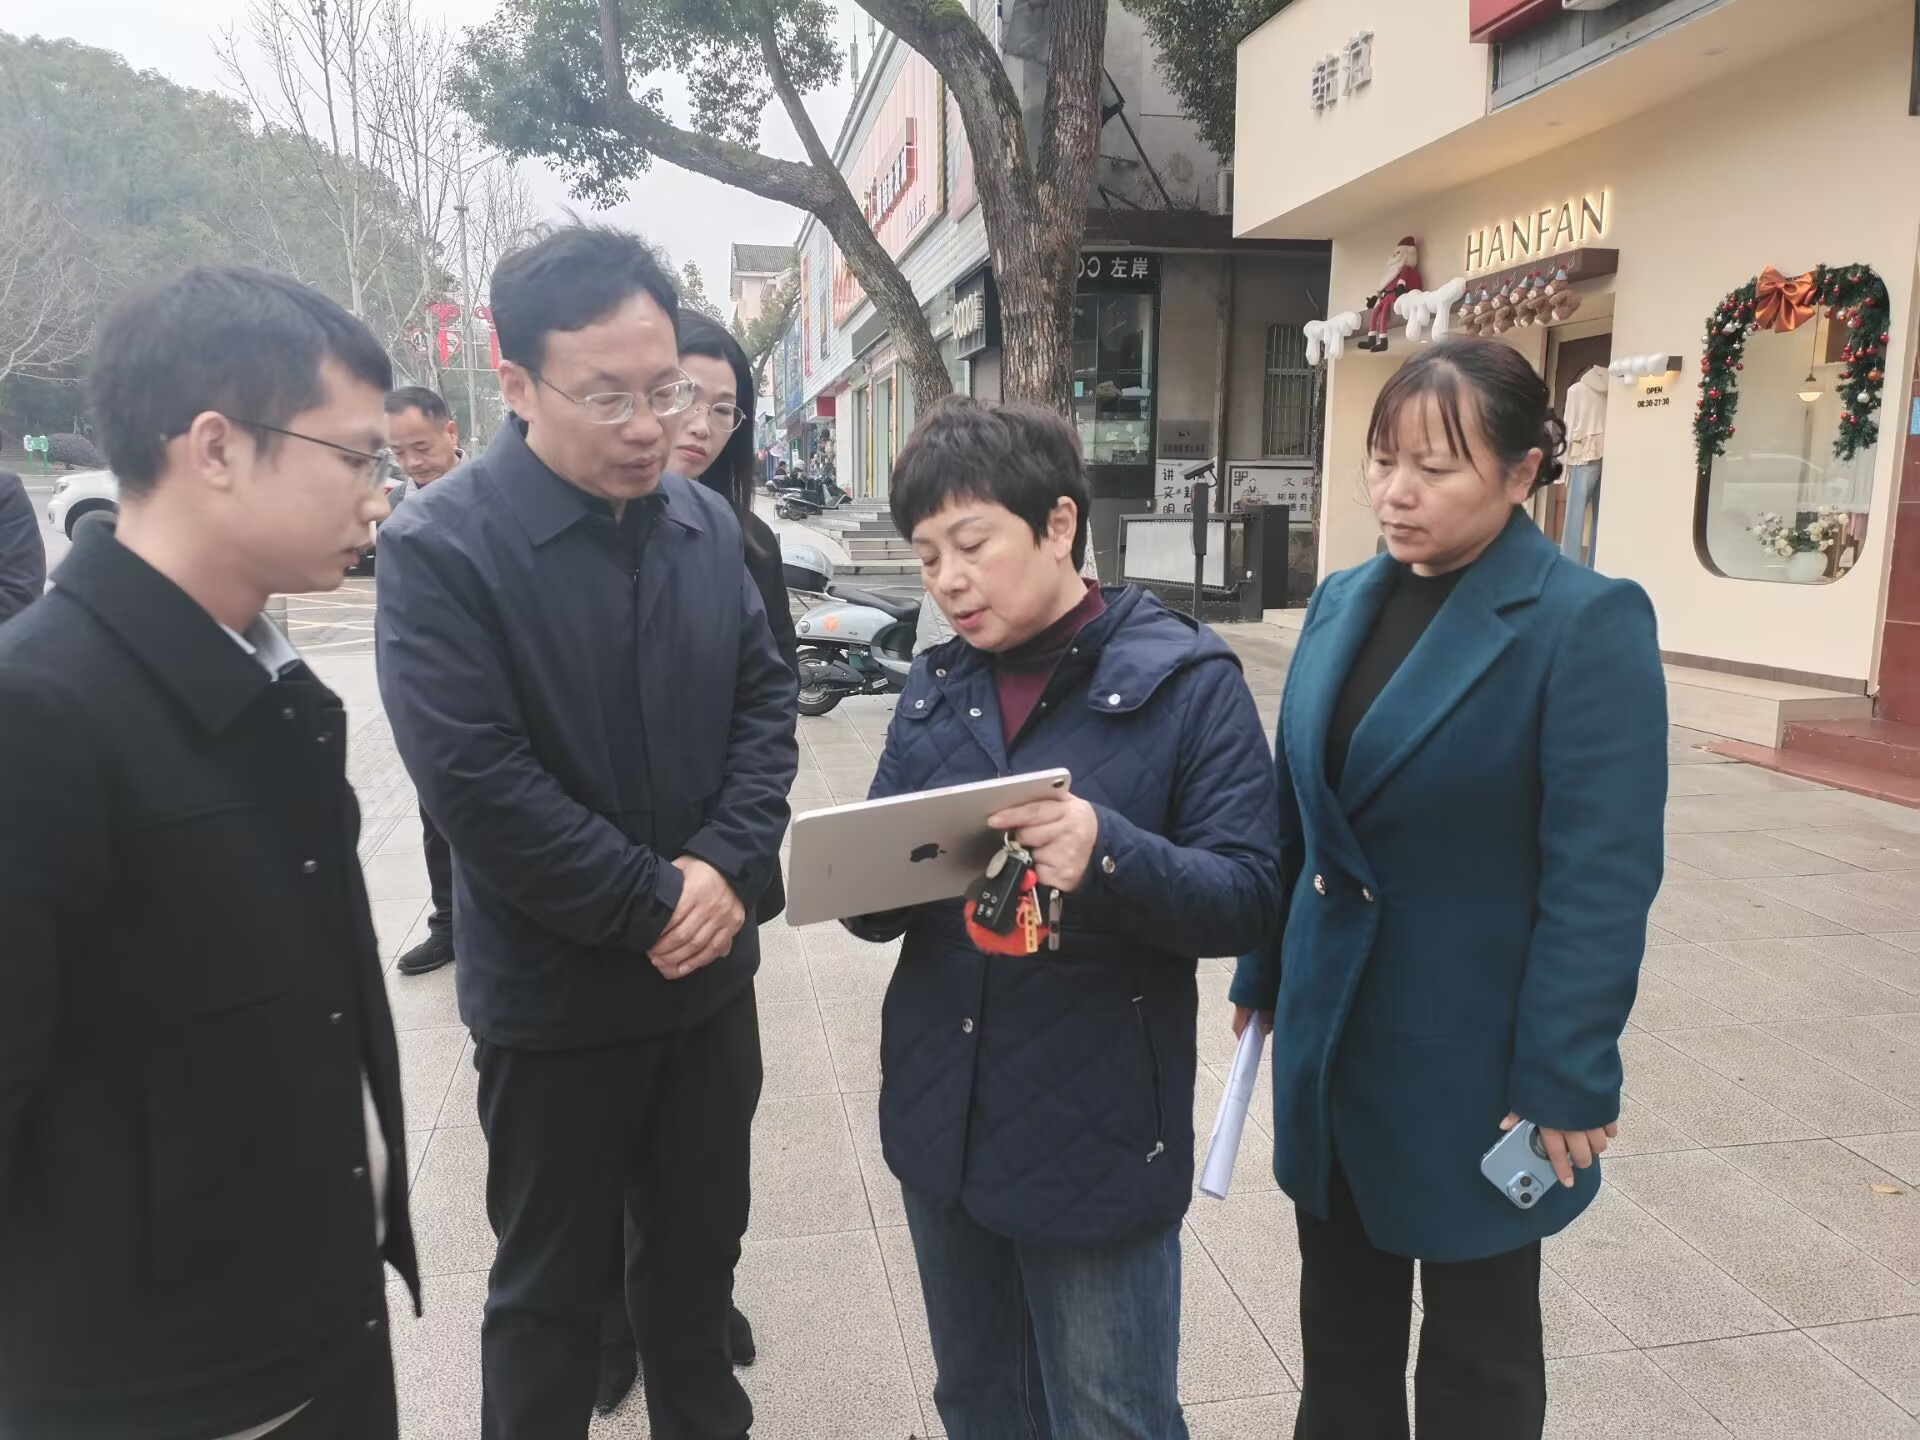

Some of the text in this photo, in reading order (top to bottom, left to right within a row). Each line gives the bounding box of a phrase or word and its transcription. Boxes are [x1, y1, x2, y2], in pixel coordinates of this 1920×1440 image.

[1465, 191, 1605, 271] HANFAN
[1110, 257, 1148, 278] 左岸
[1646, 386, 1663, 394] OPEN
[1162, 468, 1176, 514] 讲文明
